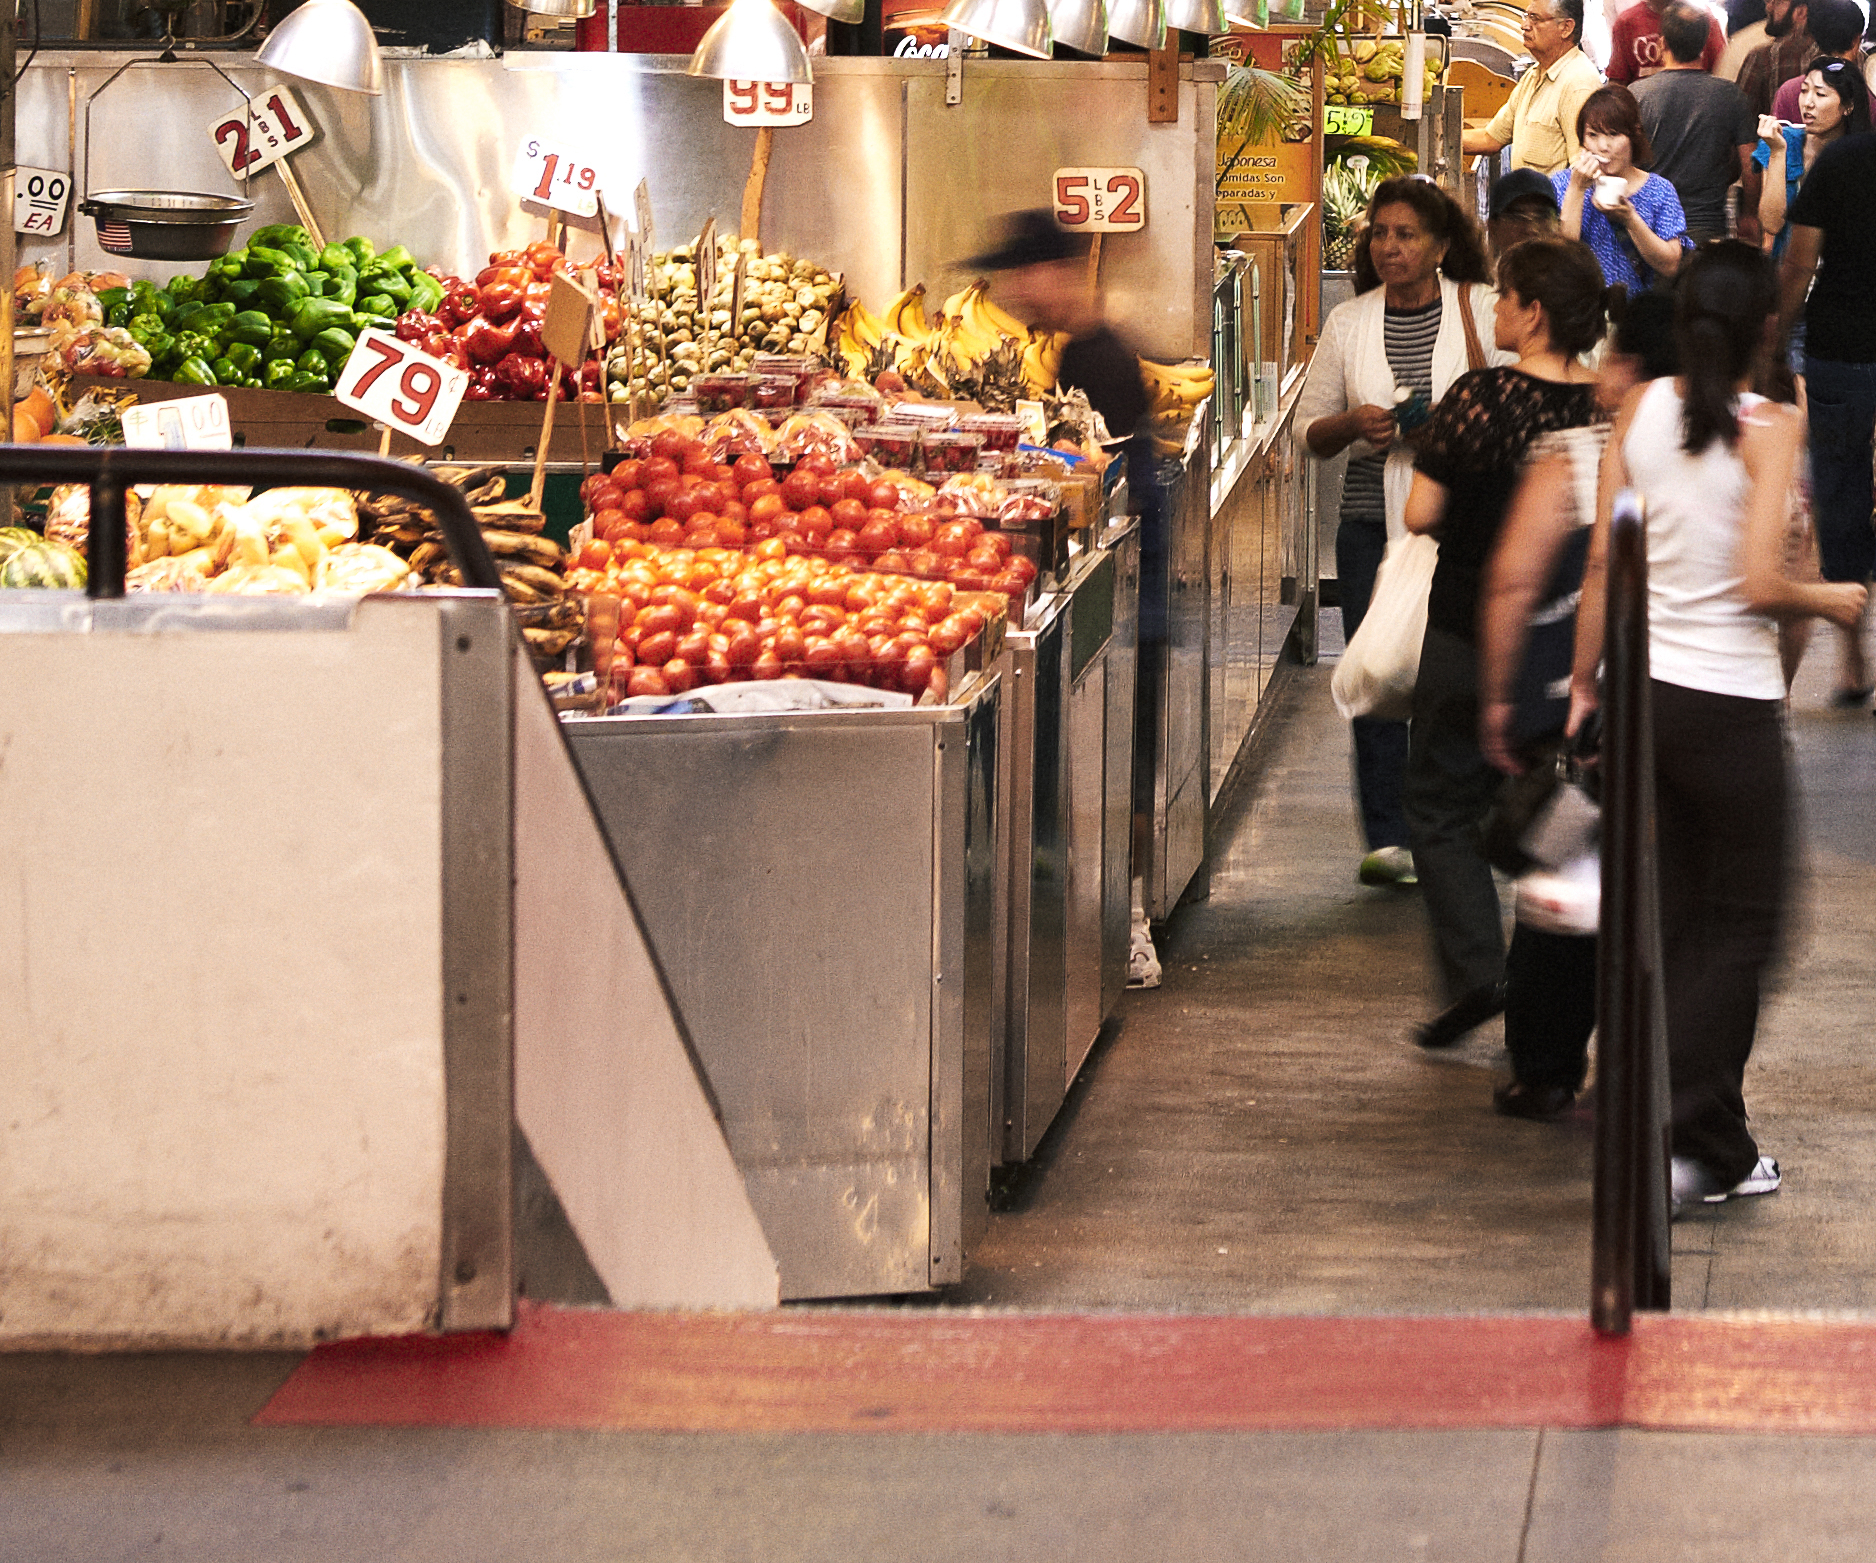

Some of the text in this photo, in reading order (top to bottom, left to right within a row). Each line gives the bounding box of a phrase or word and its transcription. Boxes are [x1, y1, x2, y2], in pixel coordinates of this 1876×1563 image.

[730, 80, 811, 116] 99 LB
[1327, 110, 1342, 134] 5
[215, 119, 262, 172] 2
[266, 94, 303, 143] 1
[1218, 152, 1277, 170] Japonesa
[1264, 173, 1284, 184] Son
[1057, 176, 1090, 225] 5
[1107, 175, 1141, 224] 2
[1269, 190, 1276, 200] y
[24, 213, 53, 231] EA
